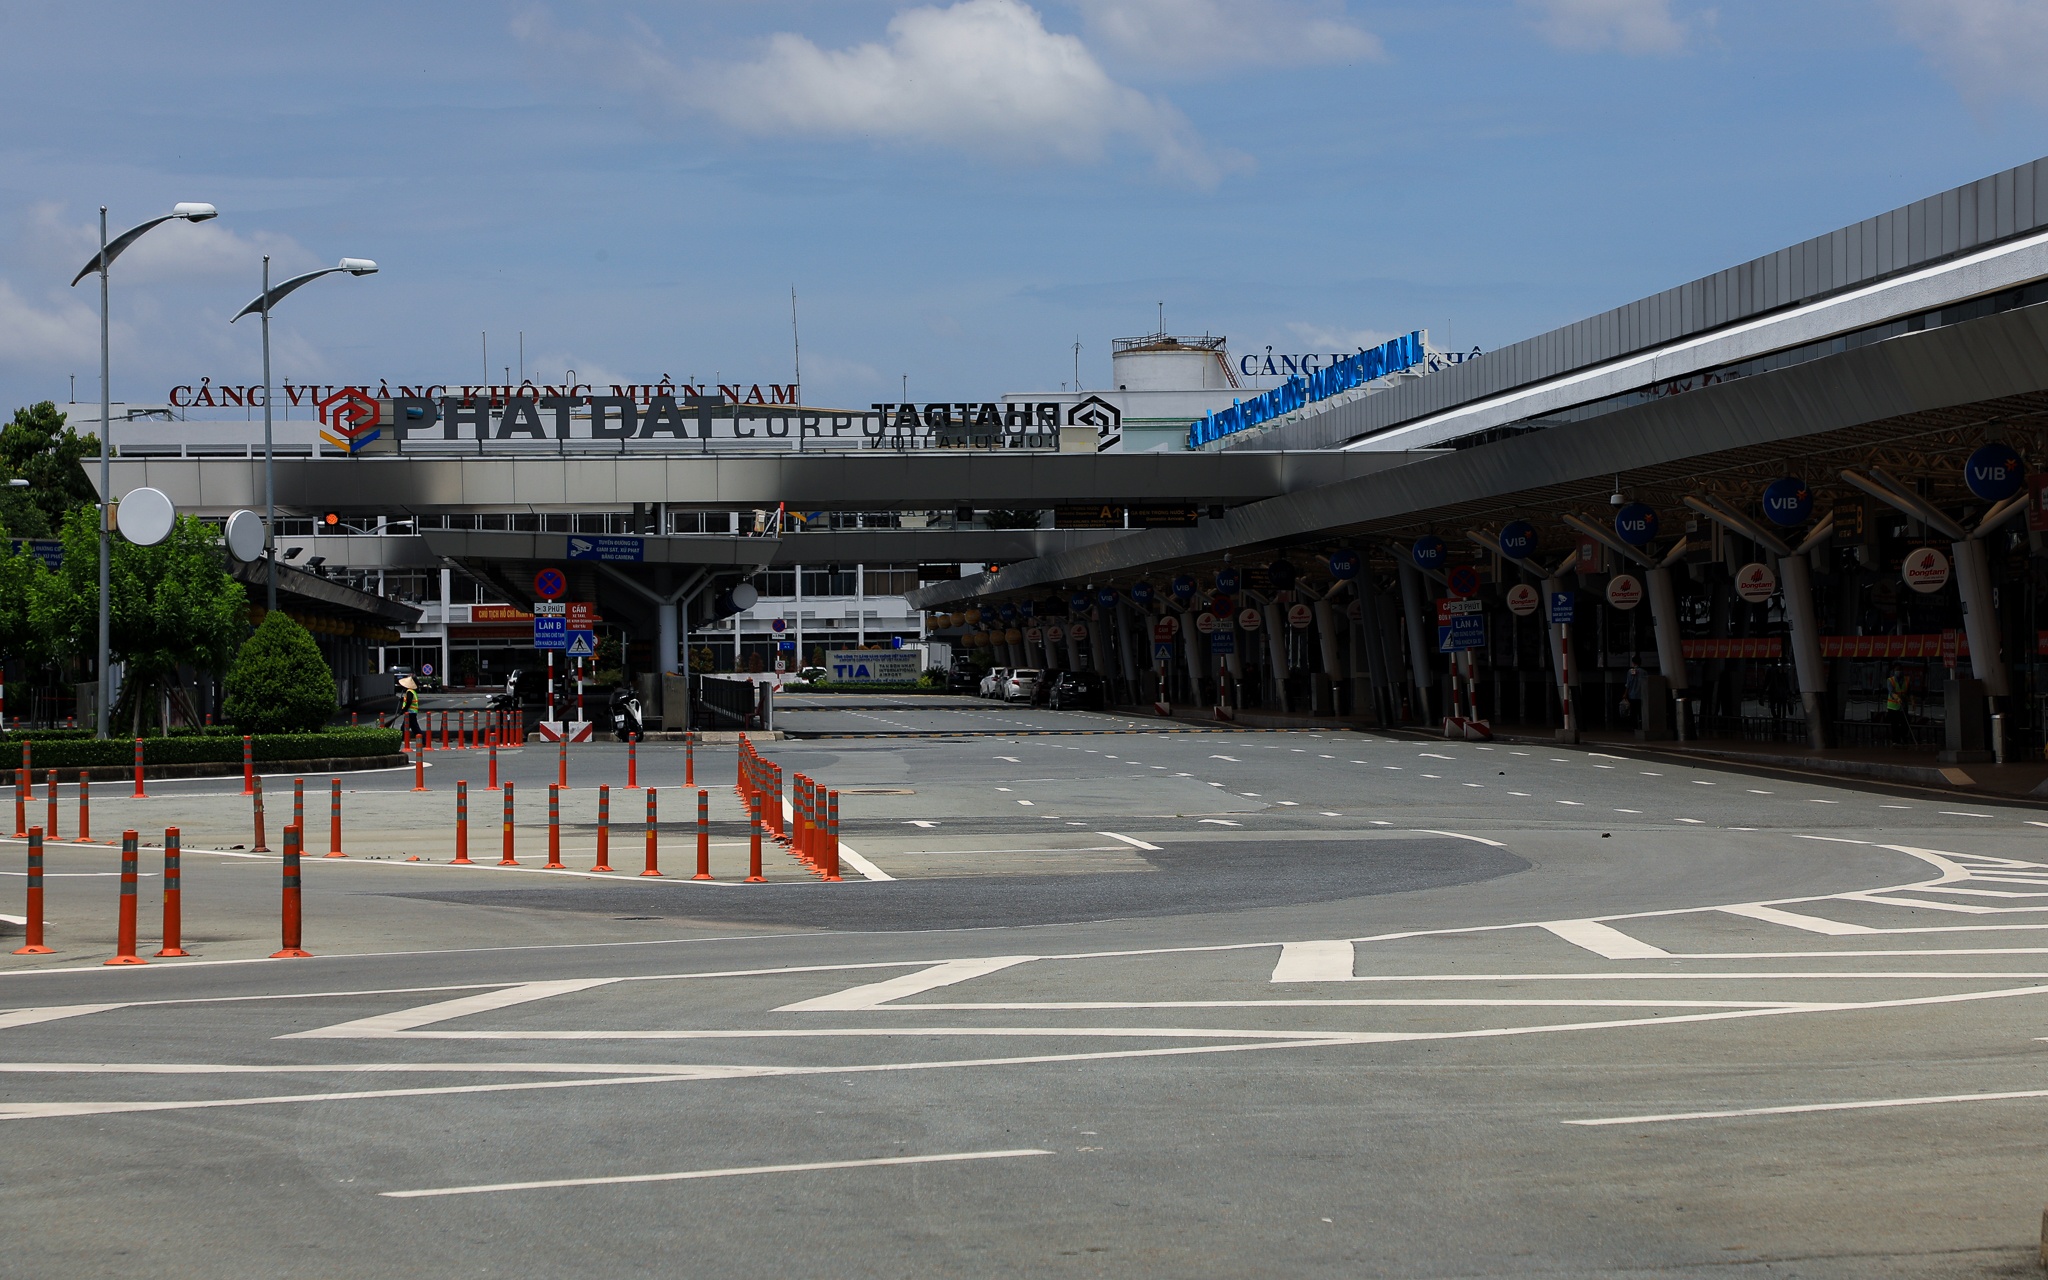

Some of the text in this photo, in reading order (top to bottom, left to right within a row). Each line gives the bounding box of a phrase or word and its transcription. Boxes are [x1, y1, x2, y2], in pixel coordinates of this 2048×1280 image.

[169, 377, 271, 408] CẢNG
[717, 384, 799, 405] NAM
[394, 397, 1061, 440] PHATDAT CORPORATION
[1974, 466, 2006, 481] VIB
[1771, 497, 1799, 510] VIB
[1622, 520, 1647, 531] VIB
[1506, 537, 1527, 548] VIB
[1418, 549, 1438, 559] VIB
[1334, 562, 1350, 570] VIB
[1909, 569, 1945, 577] Dongtam
[1176, 583, 1191, 593] VIB
[1220, 579, 1235, 587] VIB
[1741, 581, 1773, 590] Dongtam
[548, 604, 564, 612] PHÚT
[572, 604, 587, 613] CẤM
[539, 620, 562, 630] LÀN B
[1456, 618, 1479, 629] LÀN A
[833, 664, 871, 678] TIA
